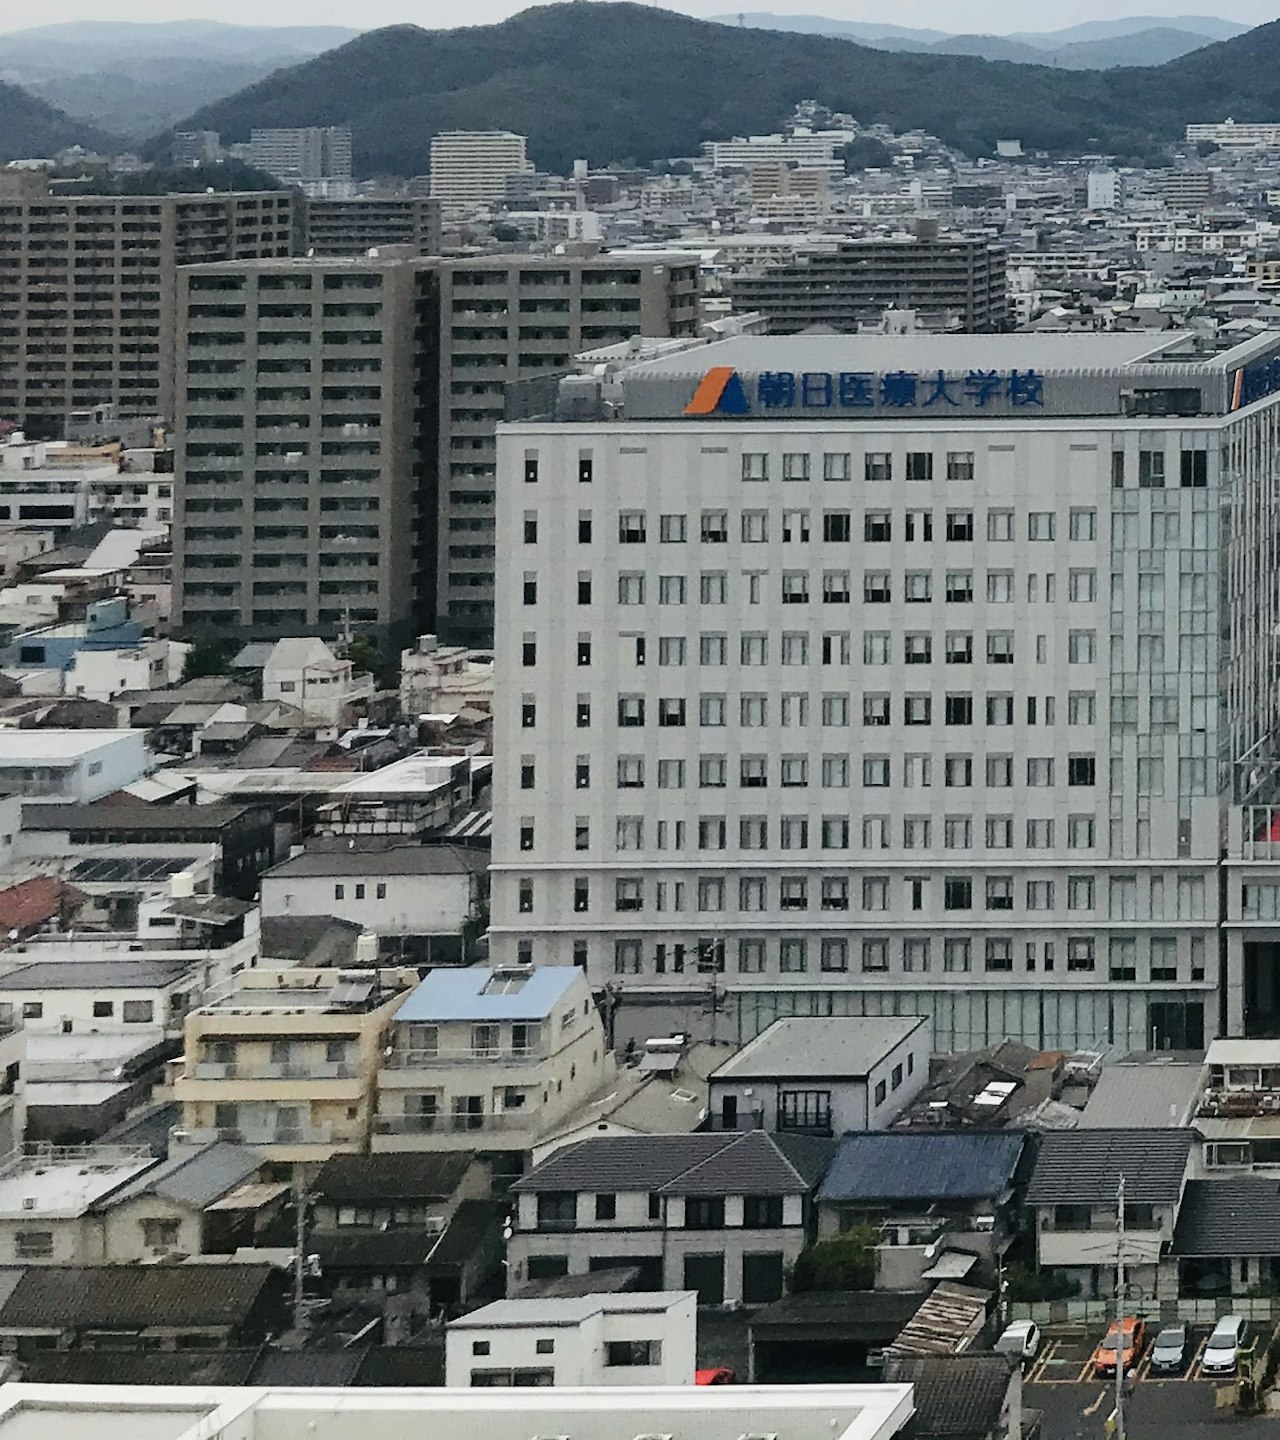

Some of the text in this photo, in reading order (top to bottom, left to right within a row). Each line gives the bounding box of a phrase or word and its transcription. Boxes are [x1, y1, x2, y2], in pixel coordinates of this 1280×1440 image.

[758, 369, 1045, 407] 朝日医療大学校
